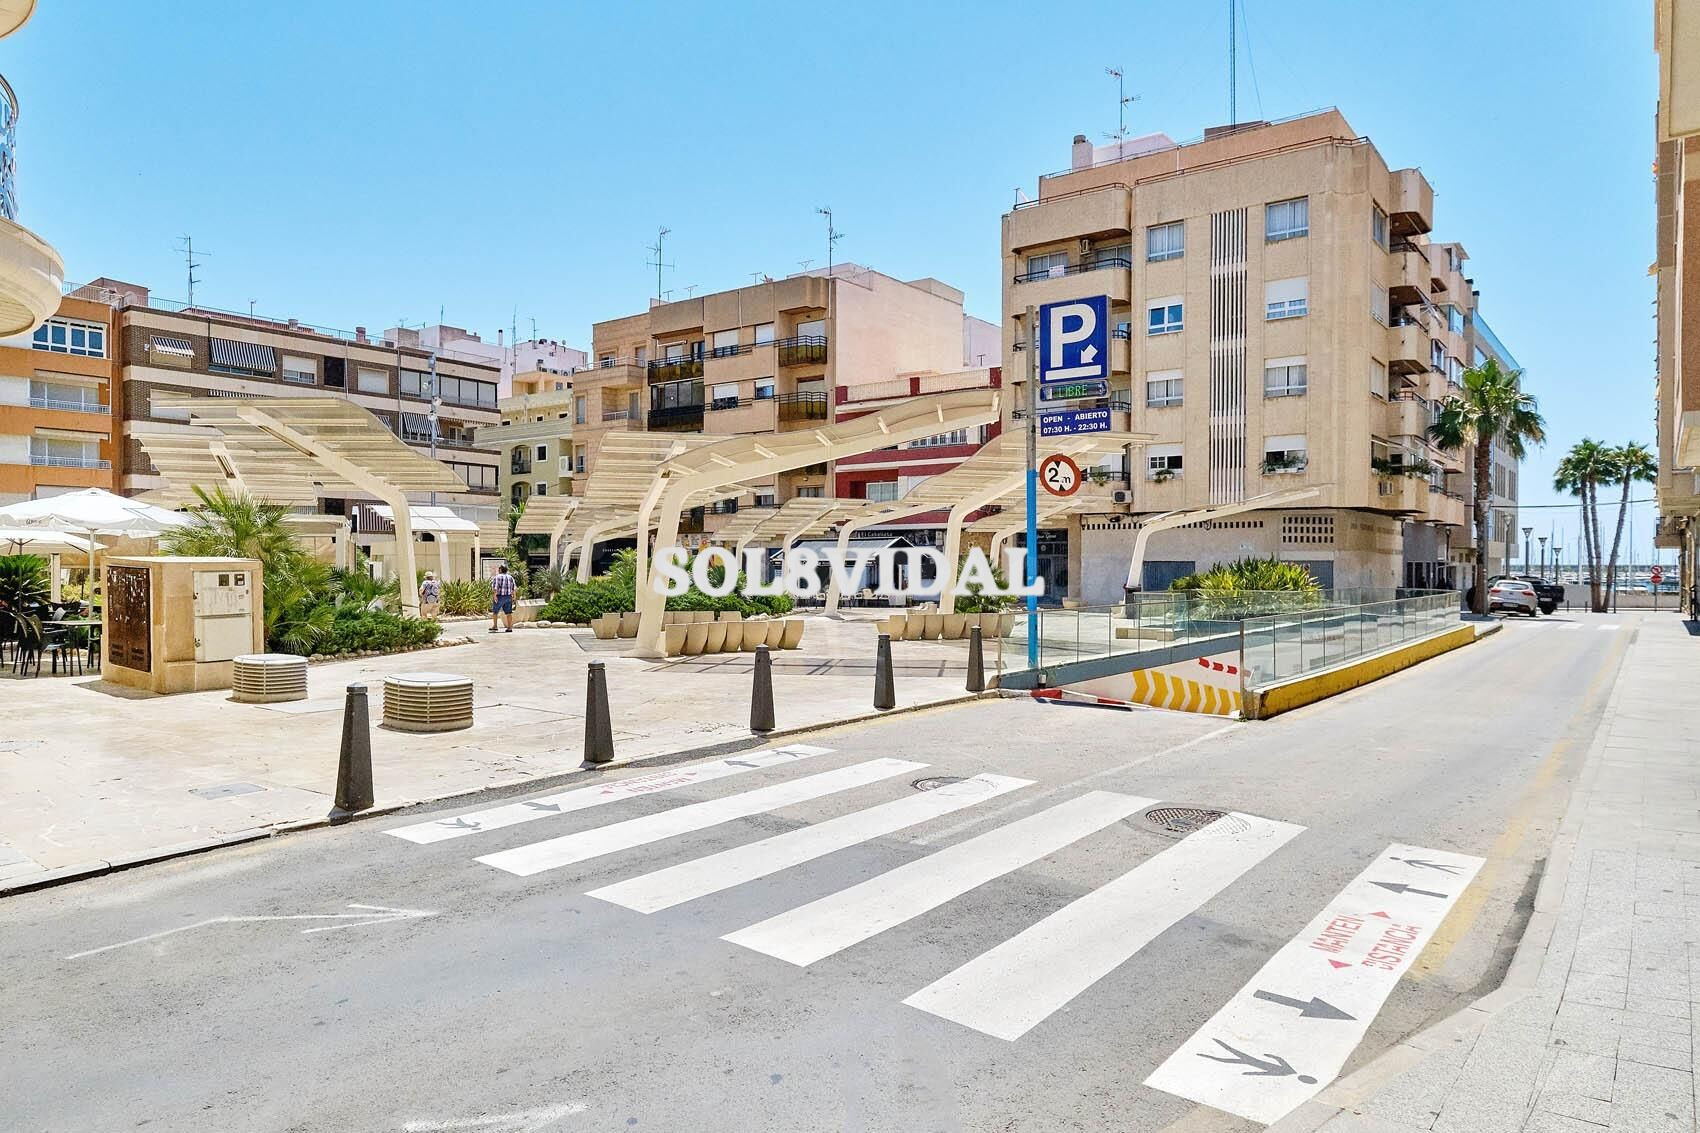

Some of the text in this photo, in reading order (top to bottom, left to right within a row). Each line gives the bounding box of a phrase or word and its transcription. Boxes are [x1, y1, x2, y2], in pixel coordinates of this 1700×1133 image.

[1050, 303, 1097, 368] P
[1058, 384, 1088, 398] LIBRE
[1043, 415, 1063, 424] OPEN
[1074, 410, 1108, 421] ABIERTO
[1043, 426, 1063, 434] 07:30
[1078, 423, 1098, 431] 22:30
[1099, 421, 1108, 429] H.
[1308, 912, 1366, 954] MANTEN
[1361, 923, 1423, 971] DISTANCIA
